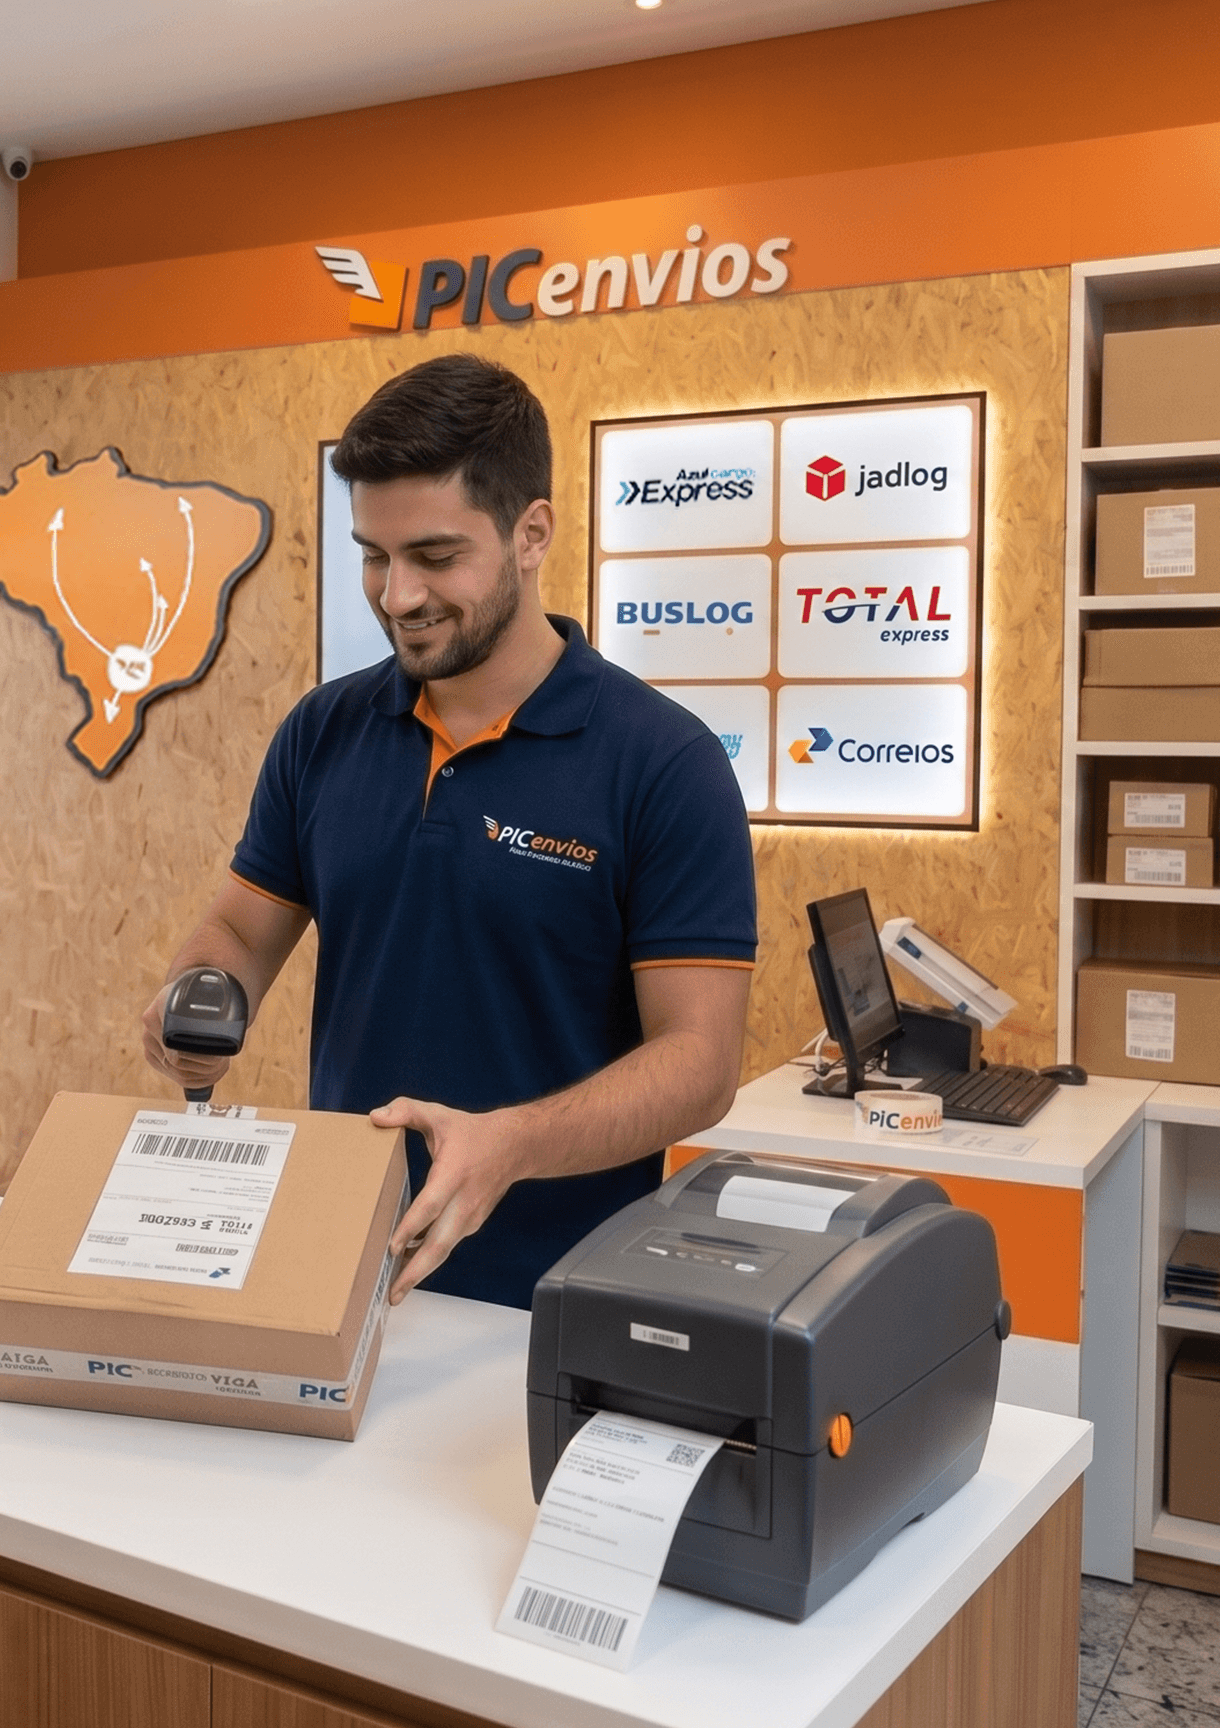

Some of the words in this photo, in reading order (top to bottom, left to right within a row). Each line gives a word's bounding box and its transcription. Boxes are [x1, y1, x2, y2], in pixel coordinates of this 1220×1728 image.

[413, 223, 792, 330] PICenvios
[854, 461, 948, 497] jadlog
[640, 479, 754, 507] Express
[616, 601, 753, 624] BUSLOG
[796, 586, 951, 624] TOTAL
[880, 628, 949, 646] express
[838, 738, 955, 763] Correios
[497, 825, 599, 863] PICenvios
[87, 1360, 134, 1379] PIC
[298, 1382, 349, 1403] PIC
